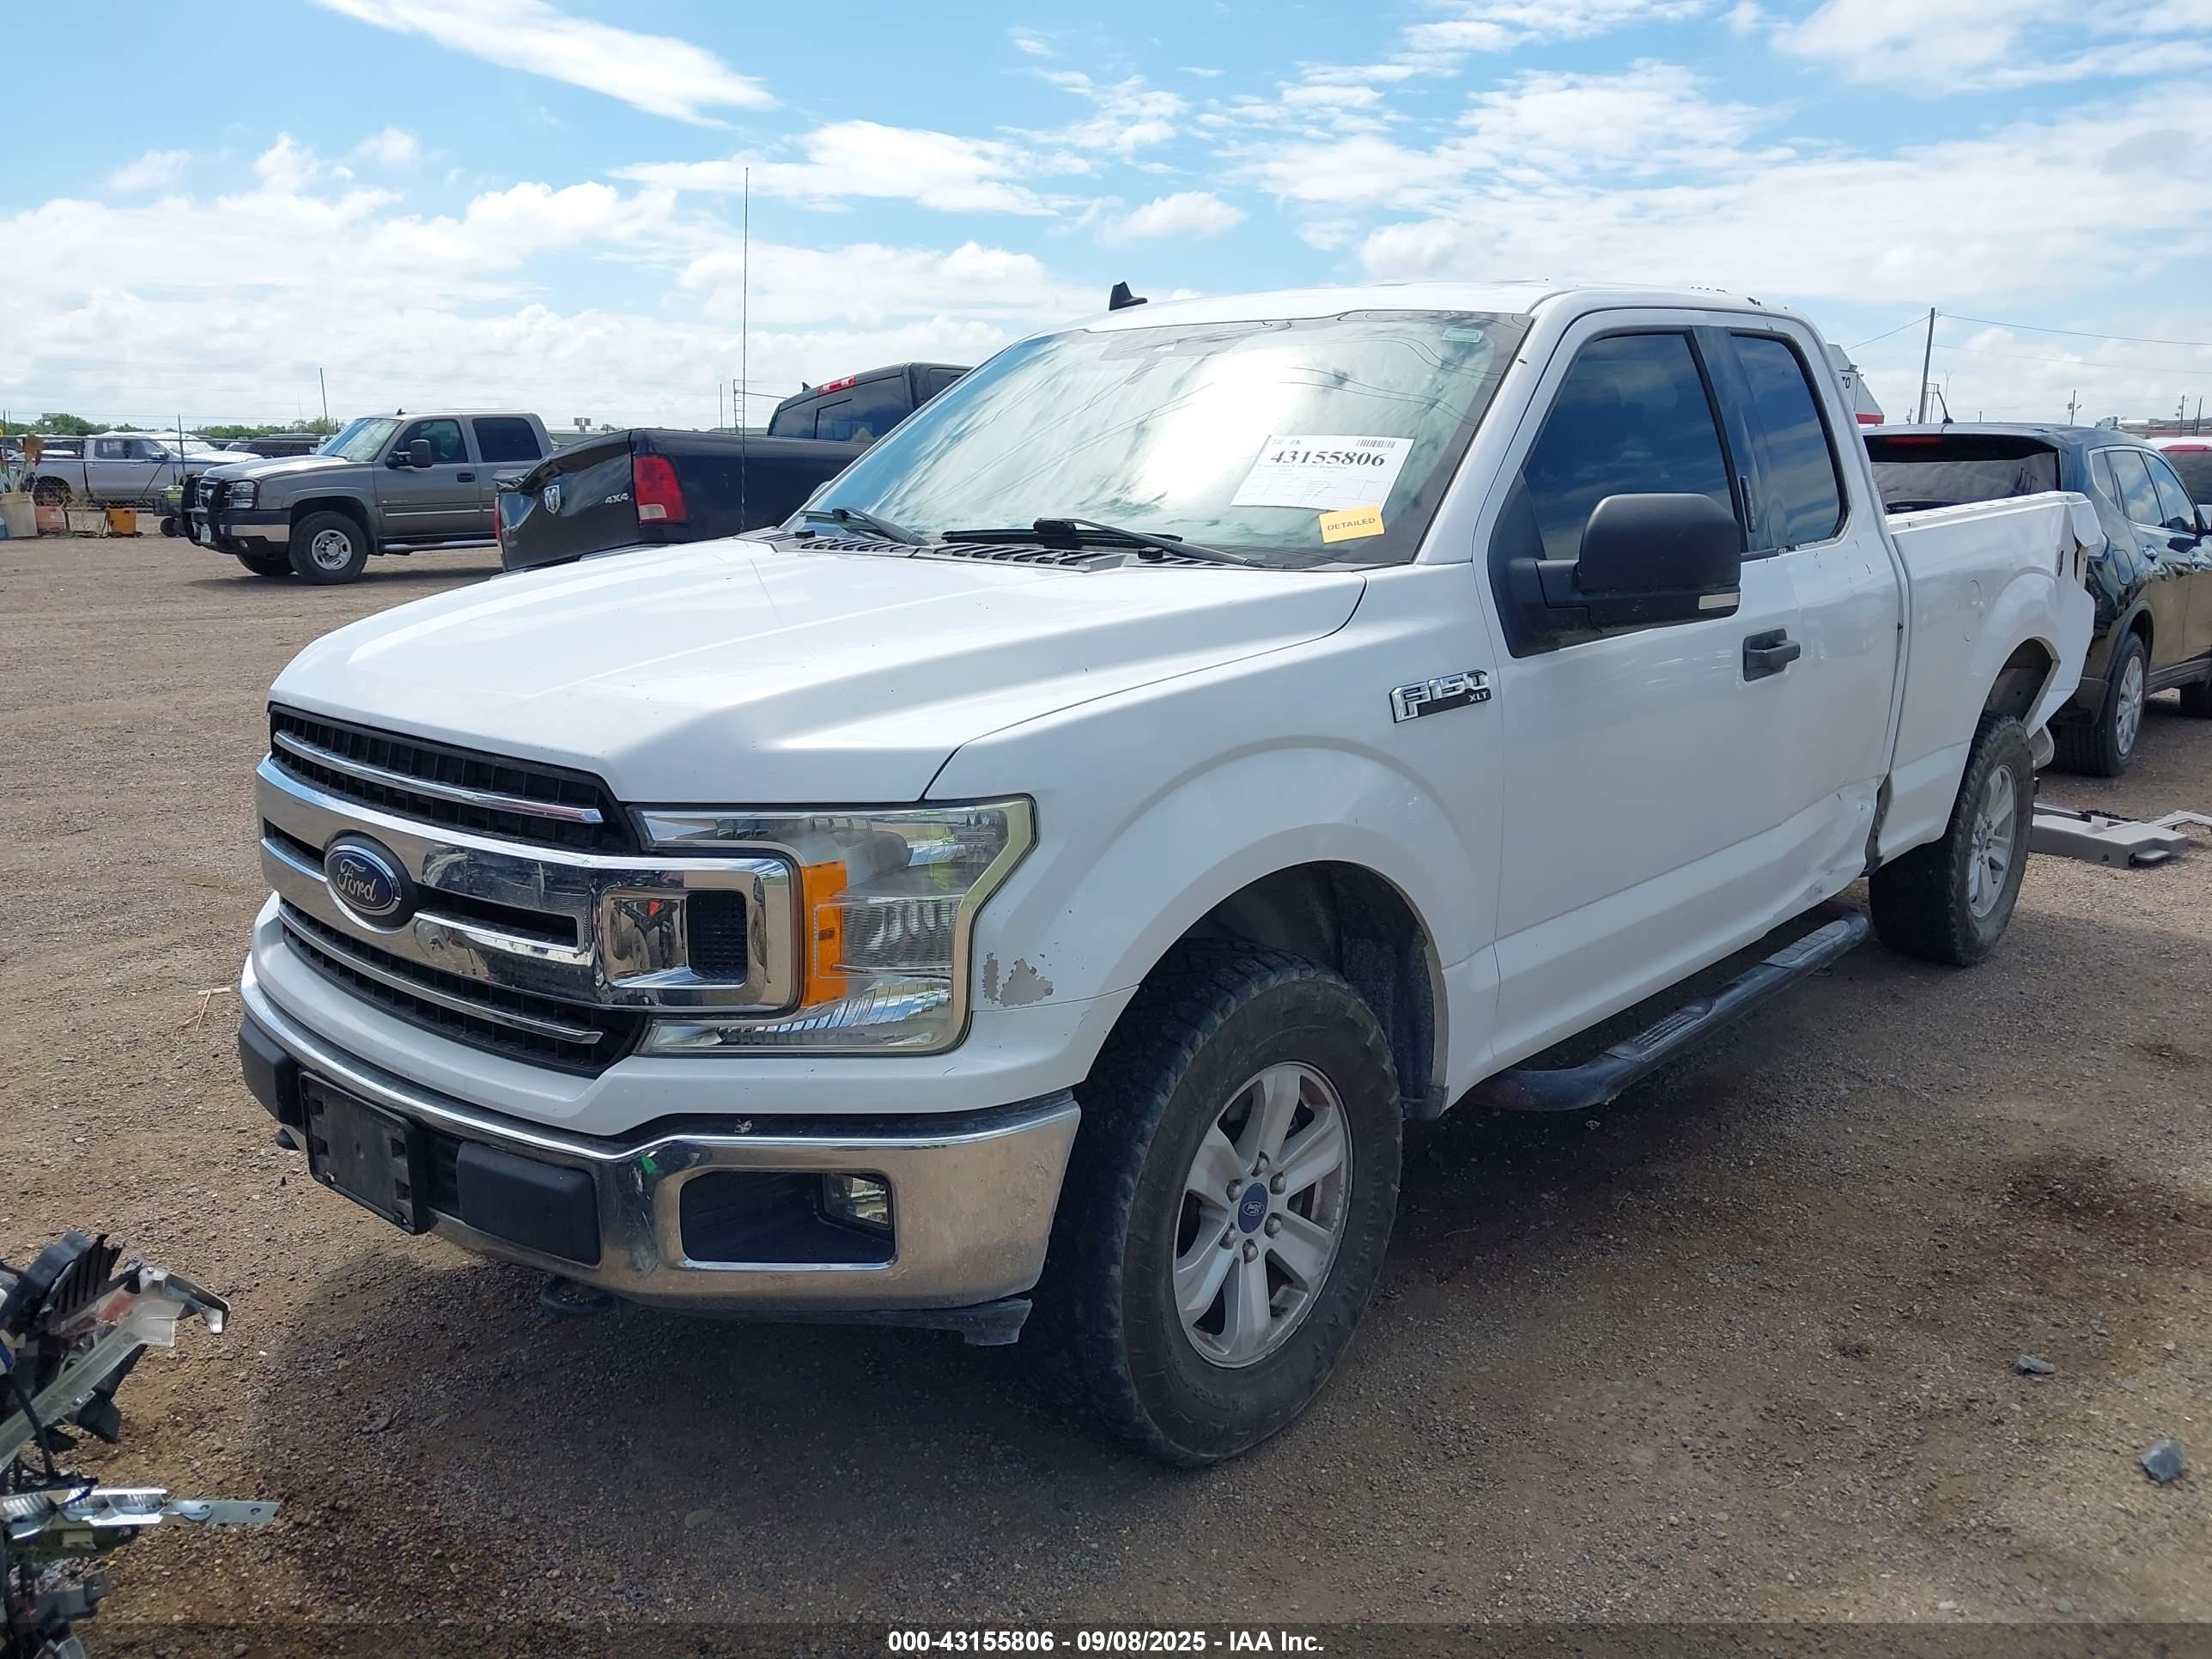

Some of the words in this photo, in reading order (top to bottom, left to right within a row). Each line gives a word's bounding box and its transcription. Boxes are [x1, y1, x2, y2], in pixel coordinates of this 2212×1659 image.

[1271, 451, 1388, 466] 43155806
[1327, 517, 1376, 531] DETAILED
[1468, 691, 1488, 702] XLT
[337, 860, 376, 901] Ford
